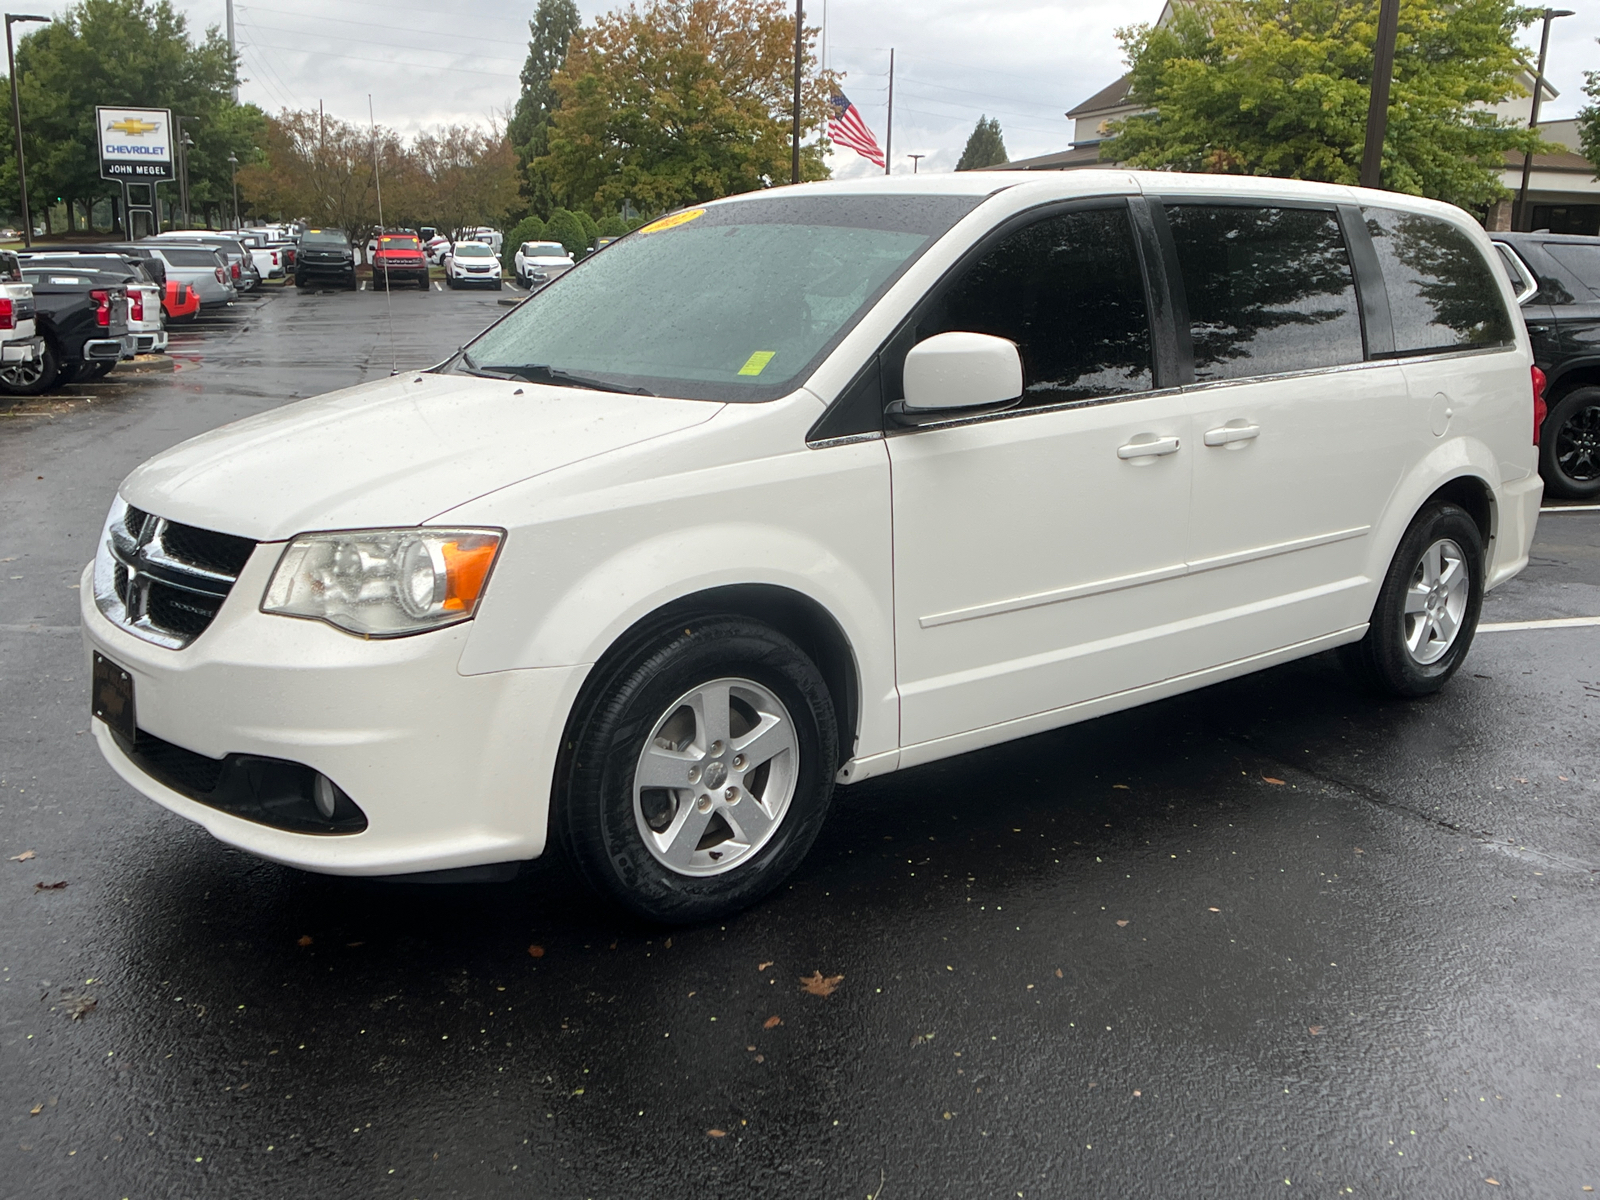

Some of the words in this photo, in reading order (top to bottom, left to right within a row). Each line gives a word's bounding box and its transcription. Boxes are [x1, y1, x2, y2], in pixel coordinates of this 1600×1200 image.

[106, 145, 164, 155] CHEVROLET
[109, 165, 132, 174] JOHN
[136, 166, 166, 175] MEGEL
